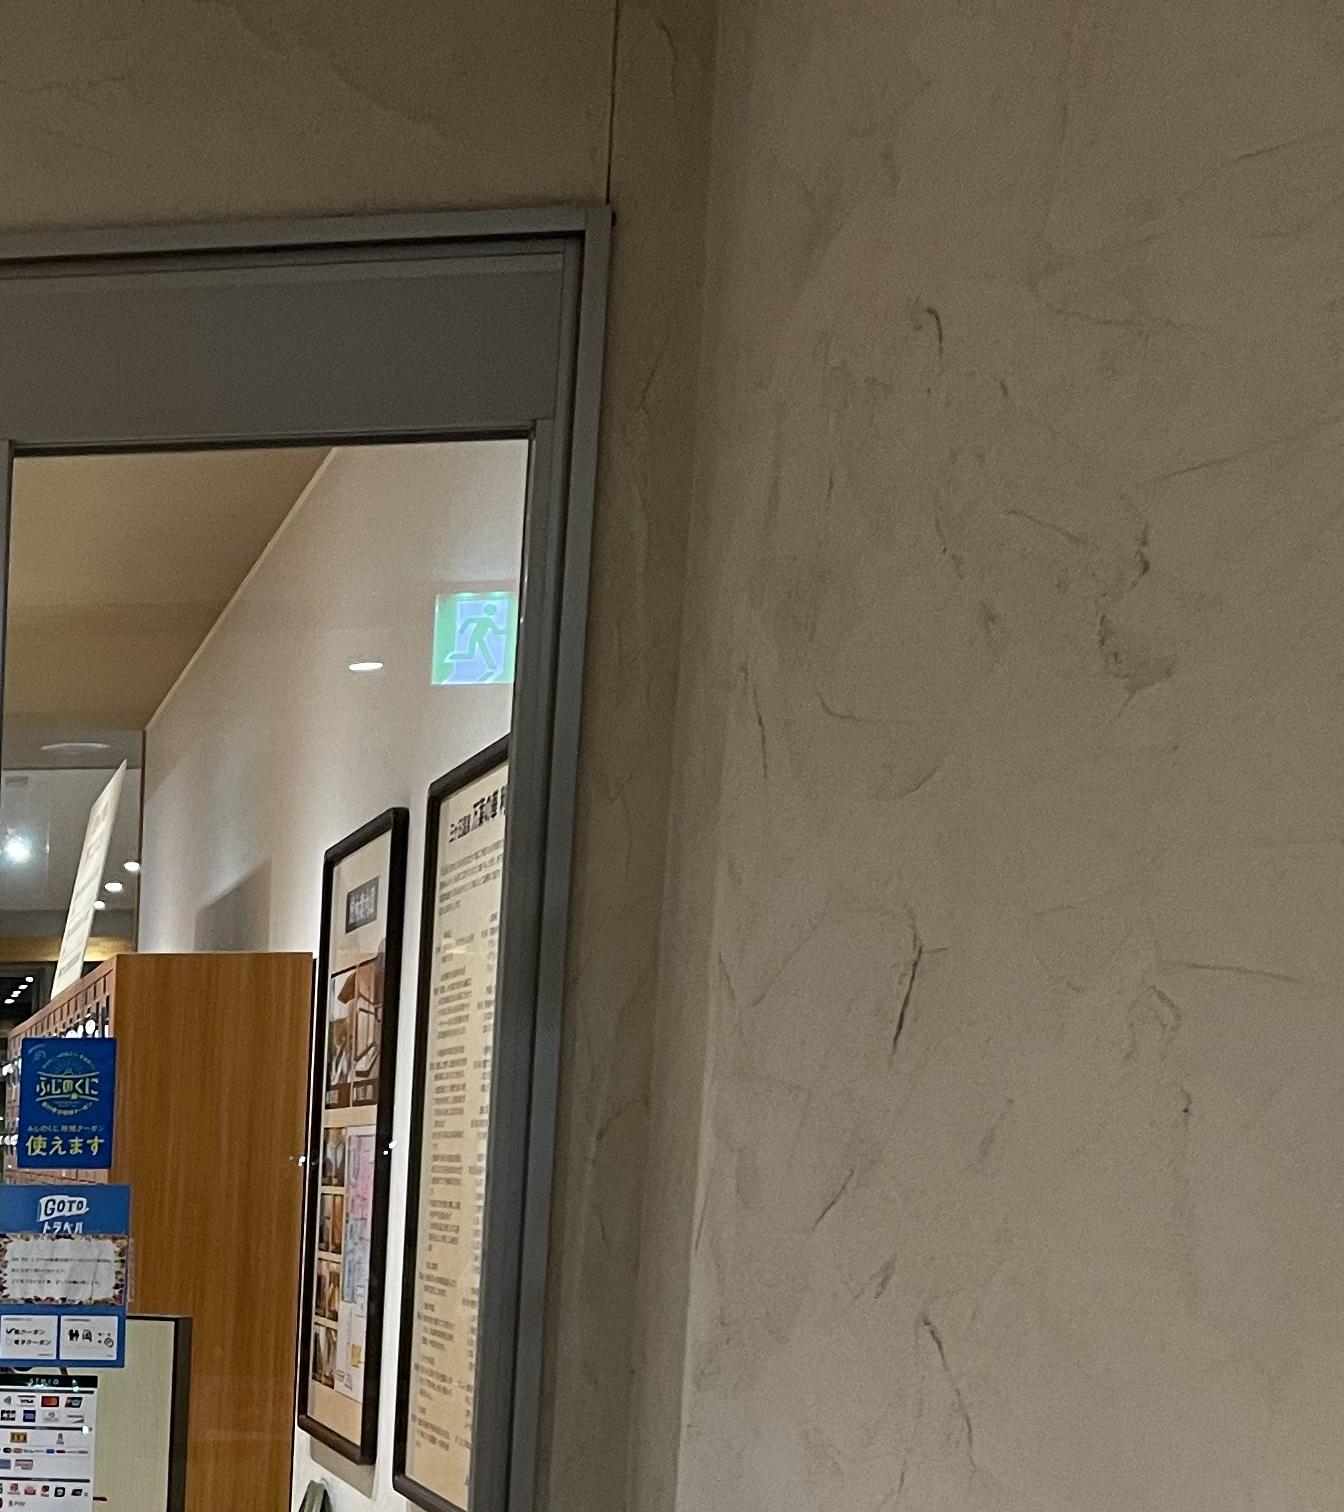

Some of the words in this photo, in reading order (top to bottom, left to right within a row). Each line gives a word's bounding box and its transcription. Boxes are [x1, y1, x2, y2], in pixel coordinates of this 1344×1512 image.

[35, 1076, 99, 1097] ふじのくに
[25, 1134, 106, 1157] 使えます
[42, 1220, 84, 1234] トラベル
